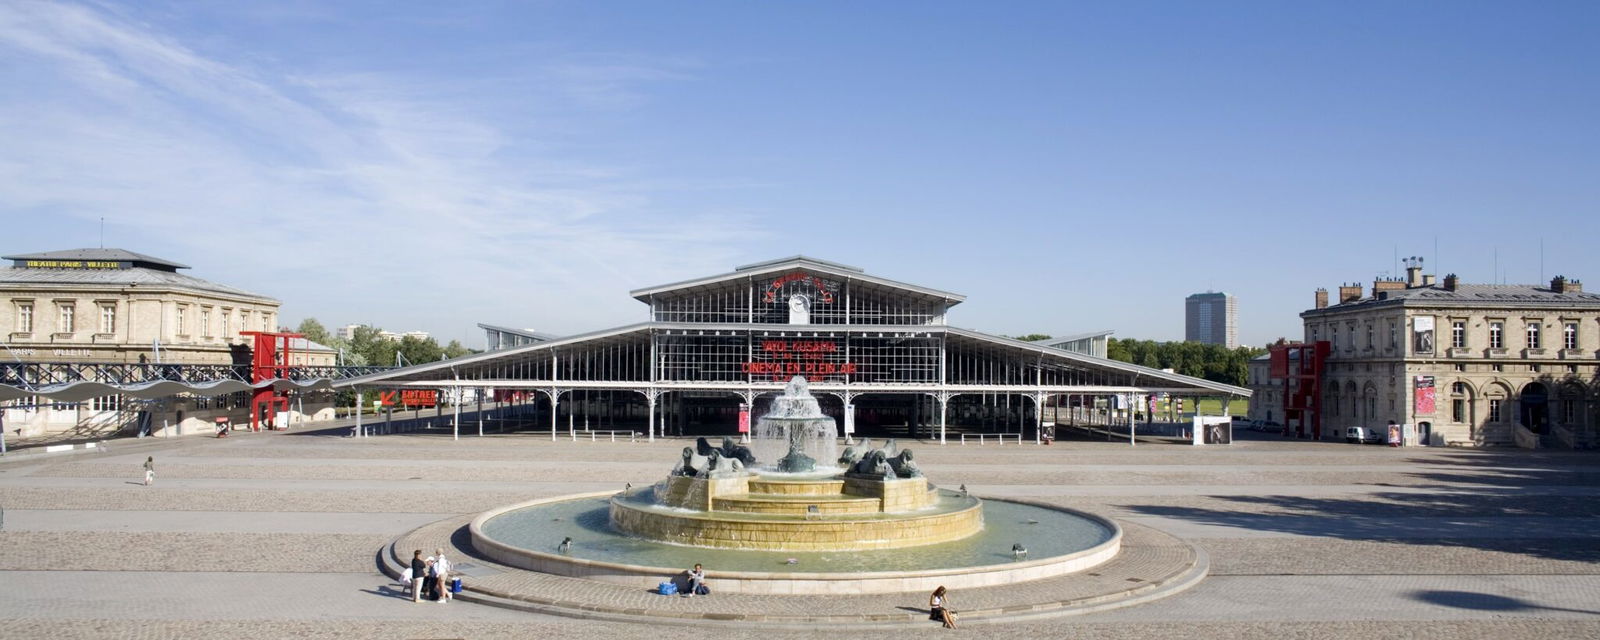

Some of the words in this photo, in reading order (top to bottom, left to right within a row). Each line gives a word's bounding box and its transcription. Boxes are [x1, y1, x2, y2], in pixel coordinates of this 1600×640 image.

[763, 341, 787, 352] YAYOI
[792, 341, 837, 352] KUSAMA
[11, 348, 36, 356] PARIS
[742, 363, 781, 374] CINEMA
[786, 363, 800, 374] EN
[805, 363, 835, 374] PLEIN
[840, 363, 857, 374] AIR
[402, 390, 435, 398] ENTREE
